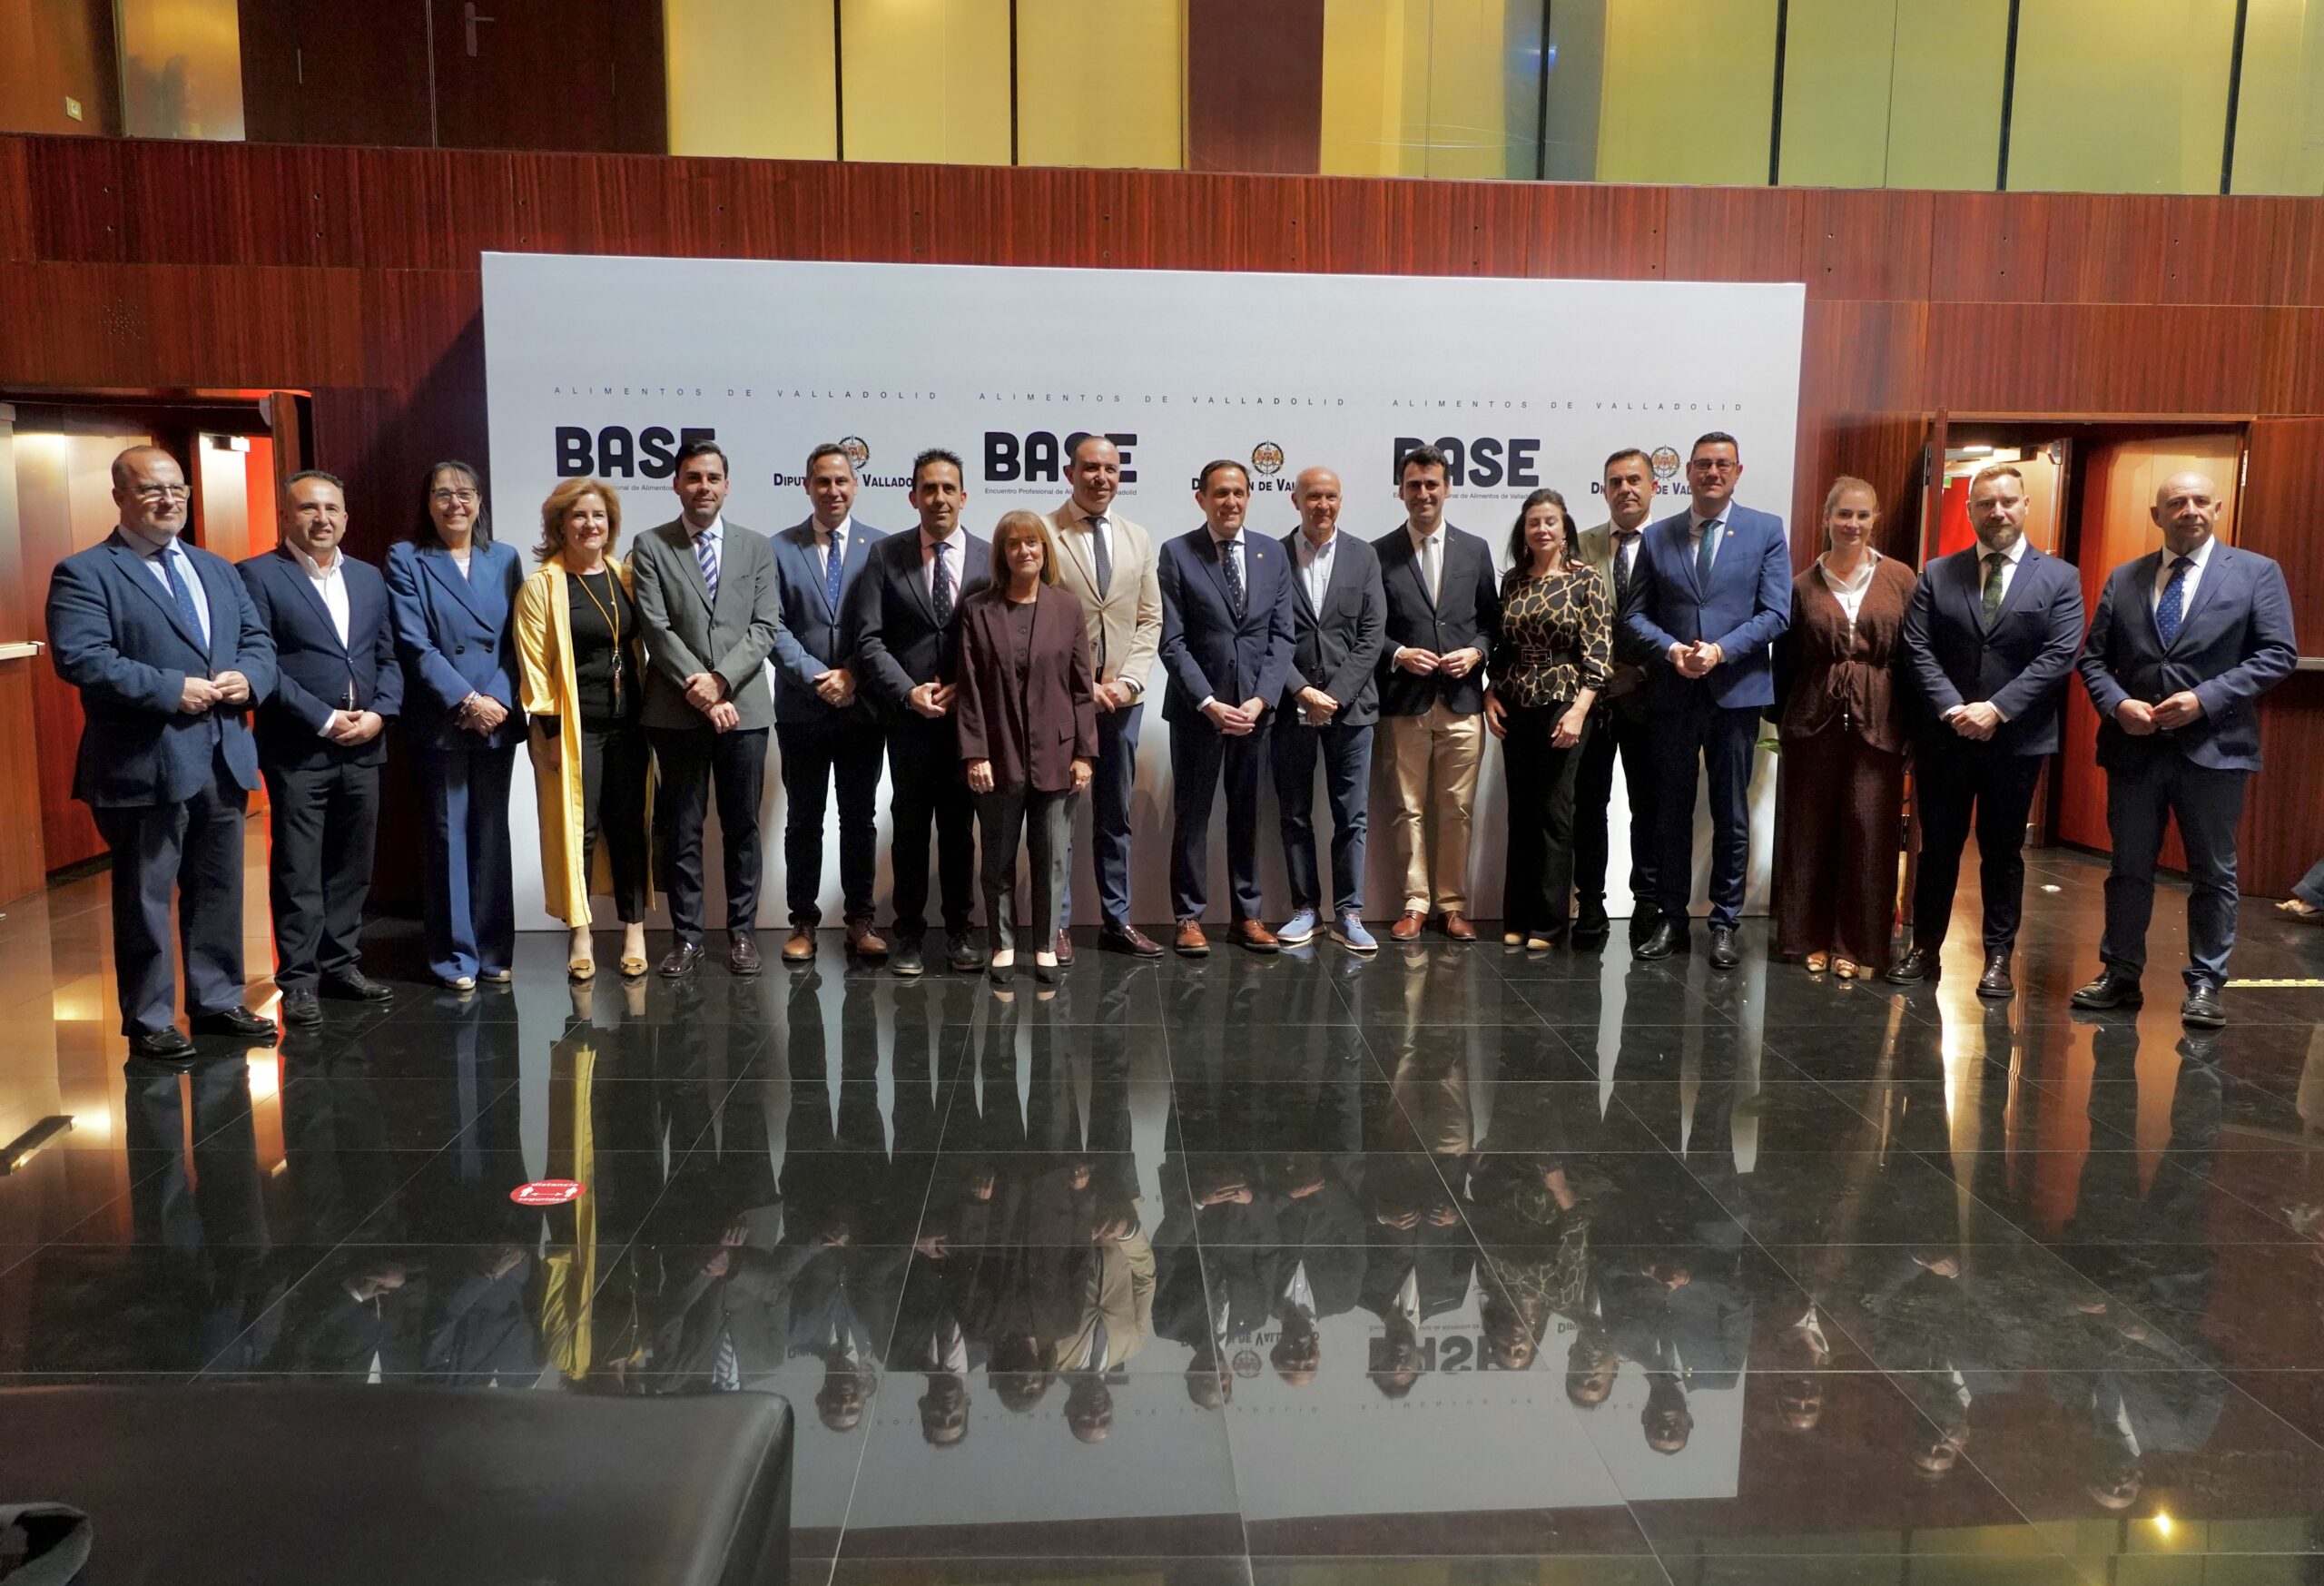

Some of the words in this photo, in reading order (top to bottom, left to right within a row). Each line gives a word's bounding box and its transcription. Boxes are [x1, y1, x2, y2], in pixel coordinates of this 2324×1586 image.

[555, 387, 702, 397] ALIMENTOS
[727, 389, 752, 397] DE
[777, 390, 937, 399] VALLADOLID
[980, 393, 1120, 402] ALIMENTOS
[1192, 397, 1344, 406] VALLADOLID
[1393, 400, 1528, 409] ALIMENTOS
[1596, 402, 1742, 410] VALLADOLID
[862, 474, 913, 487] VALLADO
[1259, 481, 1272, 491] DE
